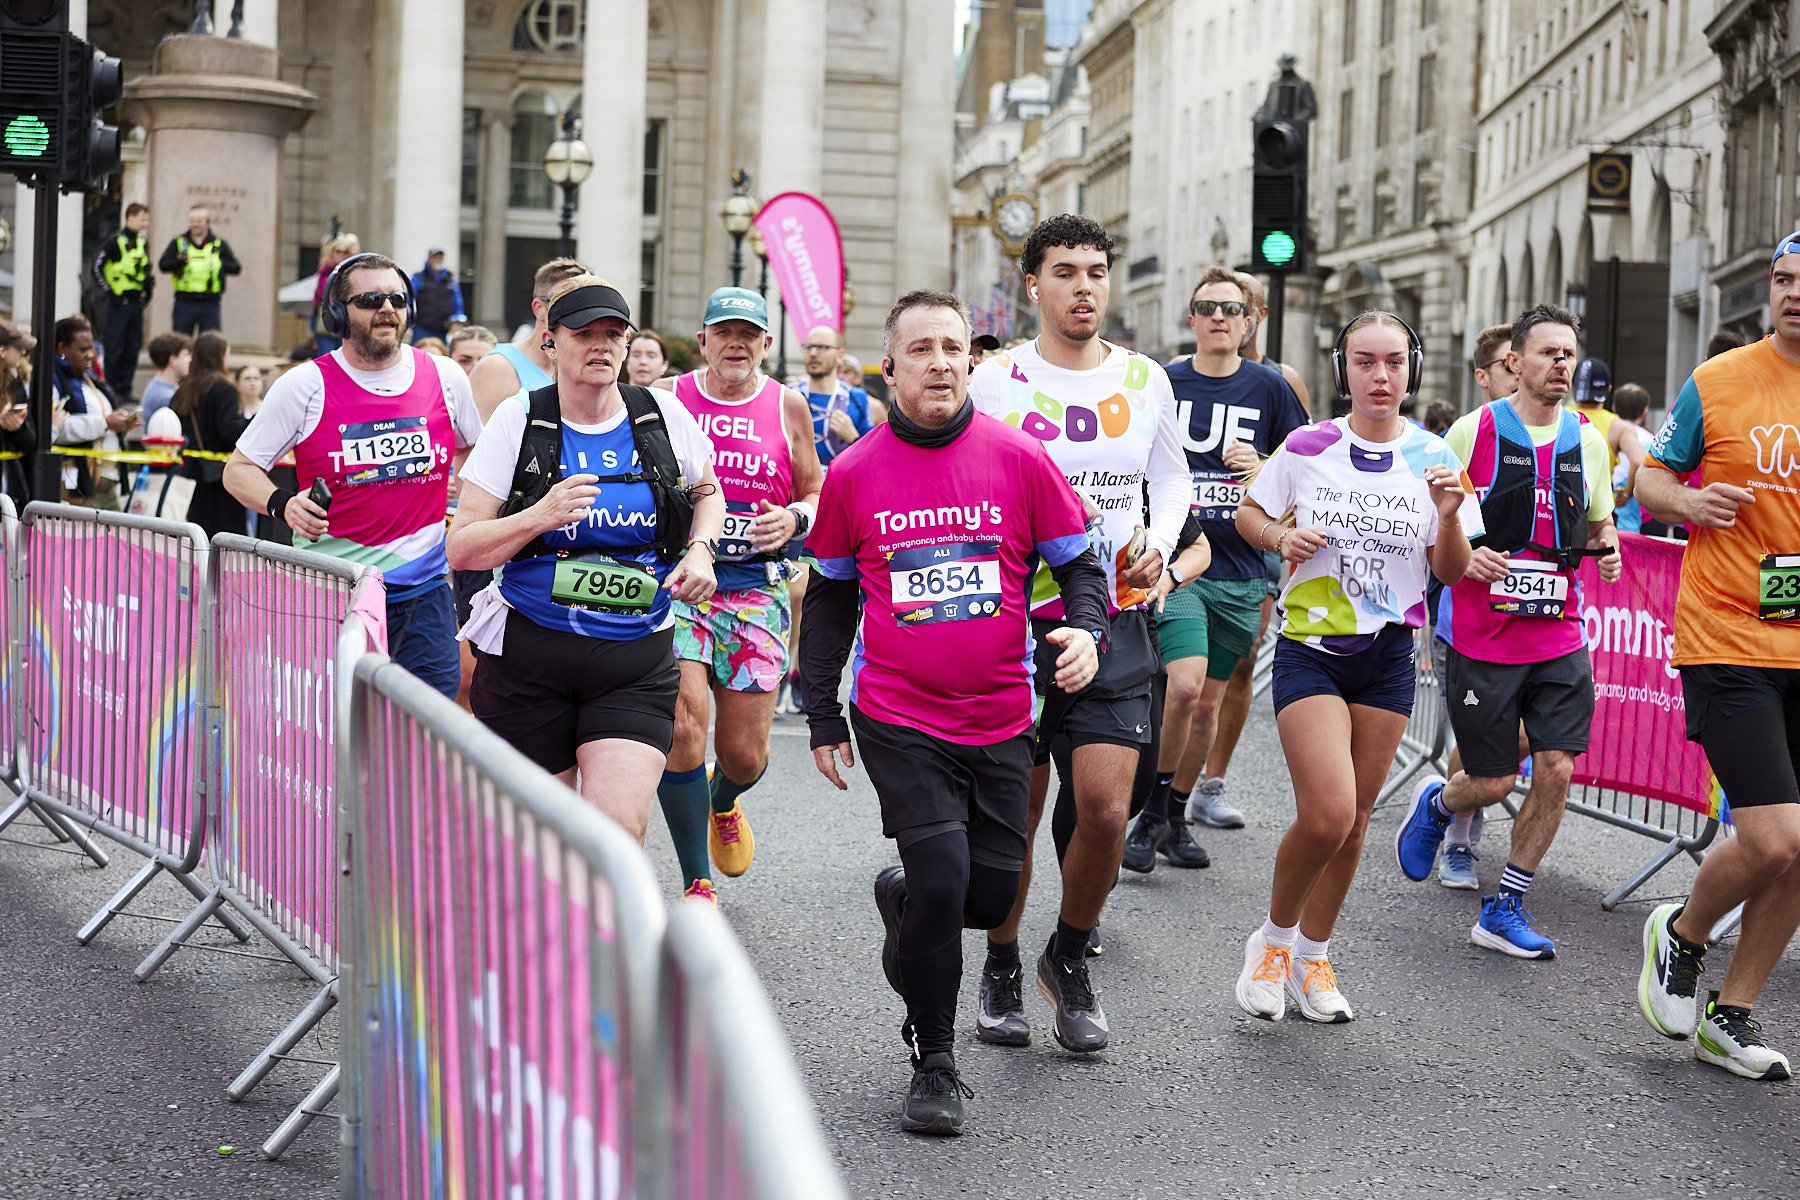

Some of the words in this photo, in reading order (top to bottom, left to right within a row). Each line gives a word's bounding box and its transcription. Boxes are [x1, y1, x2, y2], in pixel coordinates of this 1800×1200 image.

[373, 422, 395, 431] DEAN
[1174, 400, 1261, 456] UE
[350, 435, 425, 461] 11328
[712, 449, 777, 477] my's
[724, 477, 750, 488] every
[1065, 471, 1087, 486] al
[1747, 480, 1797, 494] EMPOWERING
[1090, 494, 1133, 511] harity
[1317, 487, 1343, 502] The
[1350, 491, 1420, 513] ROYAL
[874, 501, 1002, 535] Tommy's
[1312, 510, 1420, 537] MARSDEN
[878, 545, 891, 553] The
[892, 537, 936, 551] pregnancy
[938, 533, 953, 543] and
[954, 532, 974, 543] baby
[975, 532, 1003, 543] charity
[934, 549, 950, 558] ALI
[1363, 539, 1413, 560] Charity
[1340, 555, 1385, 581] FOR
[572, 568, 643, 600] 7956
[908, 566, 983, 598] 8654
[1332, 575, 1389, 606] JOHN
[1503, 574, 1556, 597] 9541
[1766, 574, 1800, 598] 23
[1628, 683, 1648, 703] and
